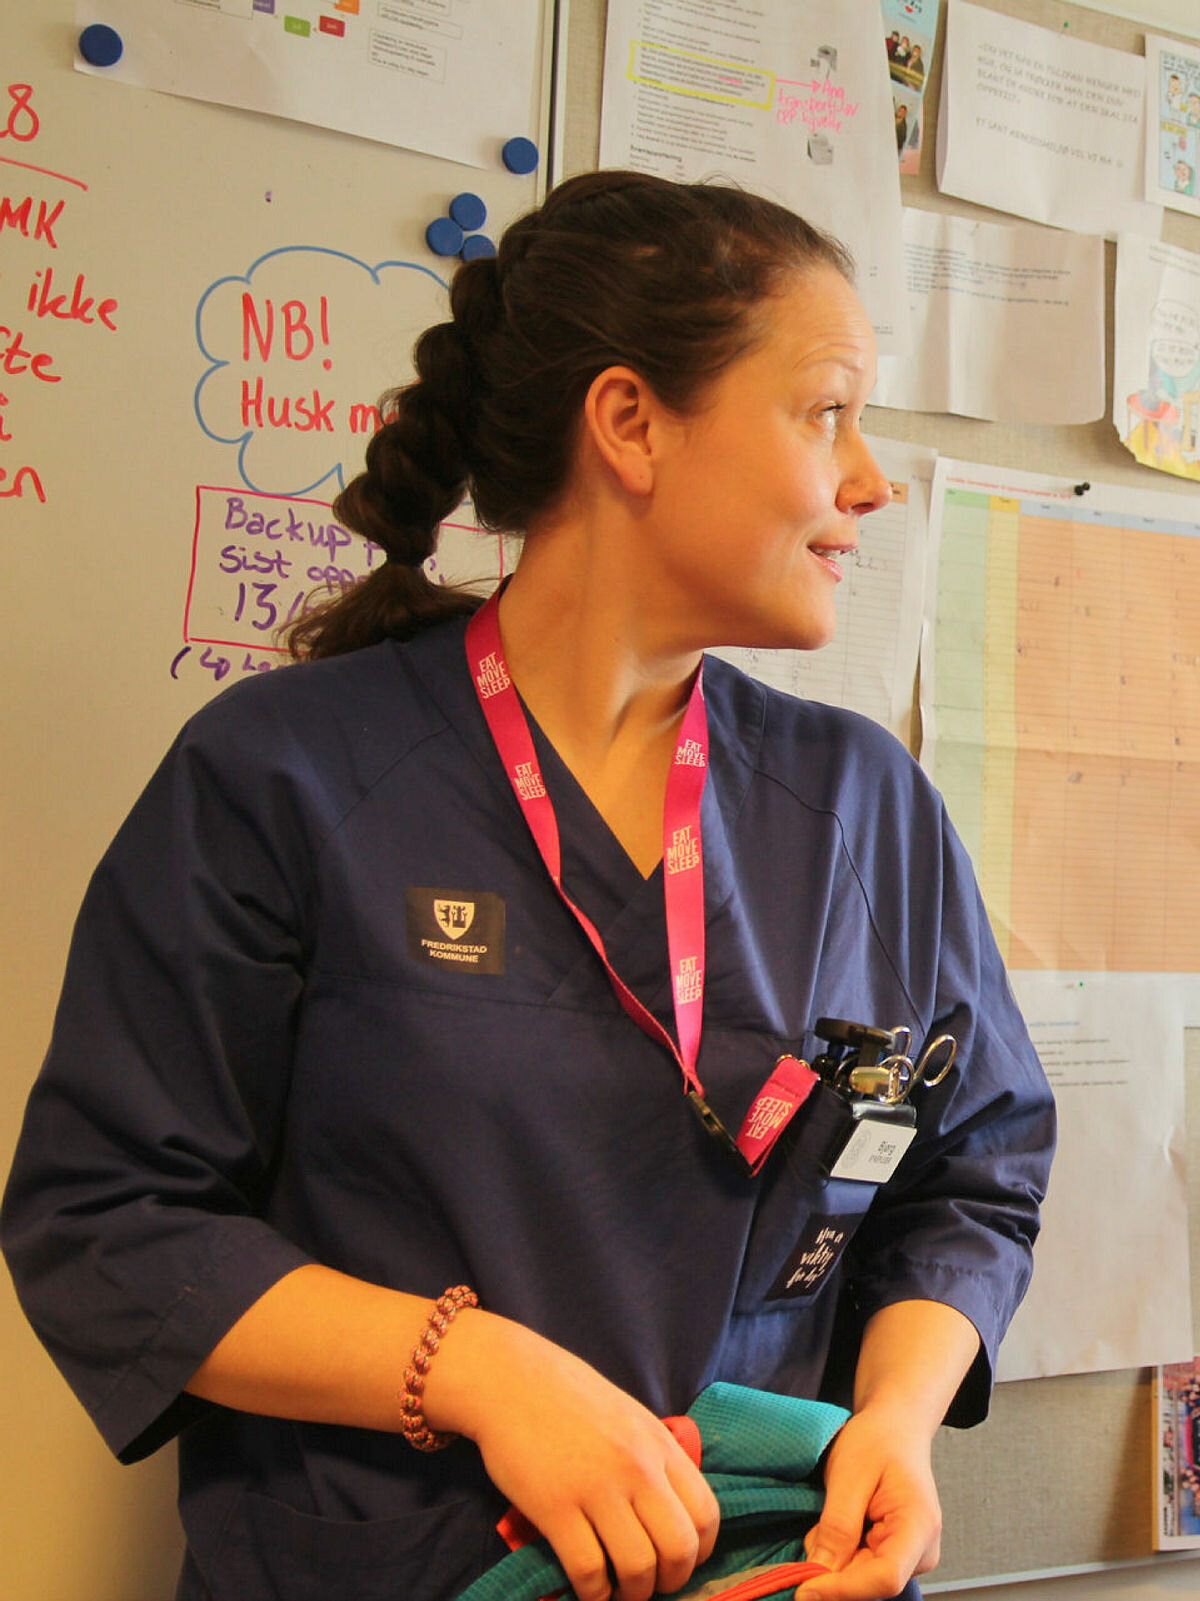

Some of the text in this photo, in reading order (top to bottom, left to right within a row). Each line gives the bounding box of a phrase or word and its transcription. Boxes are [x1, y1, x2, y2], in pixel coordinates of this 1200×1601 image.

[27, 267, 118, 330] ikke
[242, 292, 333, 371] NB!
[242, 376, 335, 433] Husk
[225, 497, 352, 562] Backup
[478, 652, 497, 674] EAT
[476, 661, 508, 688] MOVE
[480, 678, 511, 700] SLEEP
[676, 746, 706, 761] MOVE
[684, 738, 702, 752] EAT
[514, 762, 532, 778] EAT
[674, 754, 706, 768] SLEEP
[514, 773, 542, 792] MOVE
[518, 787, 546, 801] SLEEP
[672, 825, 692, 846] EAT
[666, 838, 698, 860] MOVE
[667, 854, 700, 875] SLEEP
[421, 938, 488, 954] FREDRIKSTAD
[429, 950, 479, 963] KOMMUNE
[679, 956, 698, 974] EAT
[676, 970, 702, 988] MOVE
[676, 987, 702, 1006] SLEEP
[756, 1096, 793, 1117] SLEEP
[748, 1110, 784, 1130] MOVE
[745, 1123, 769, 1140] EAT
